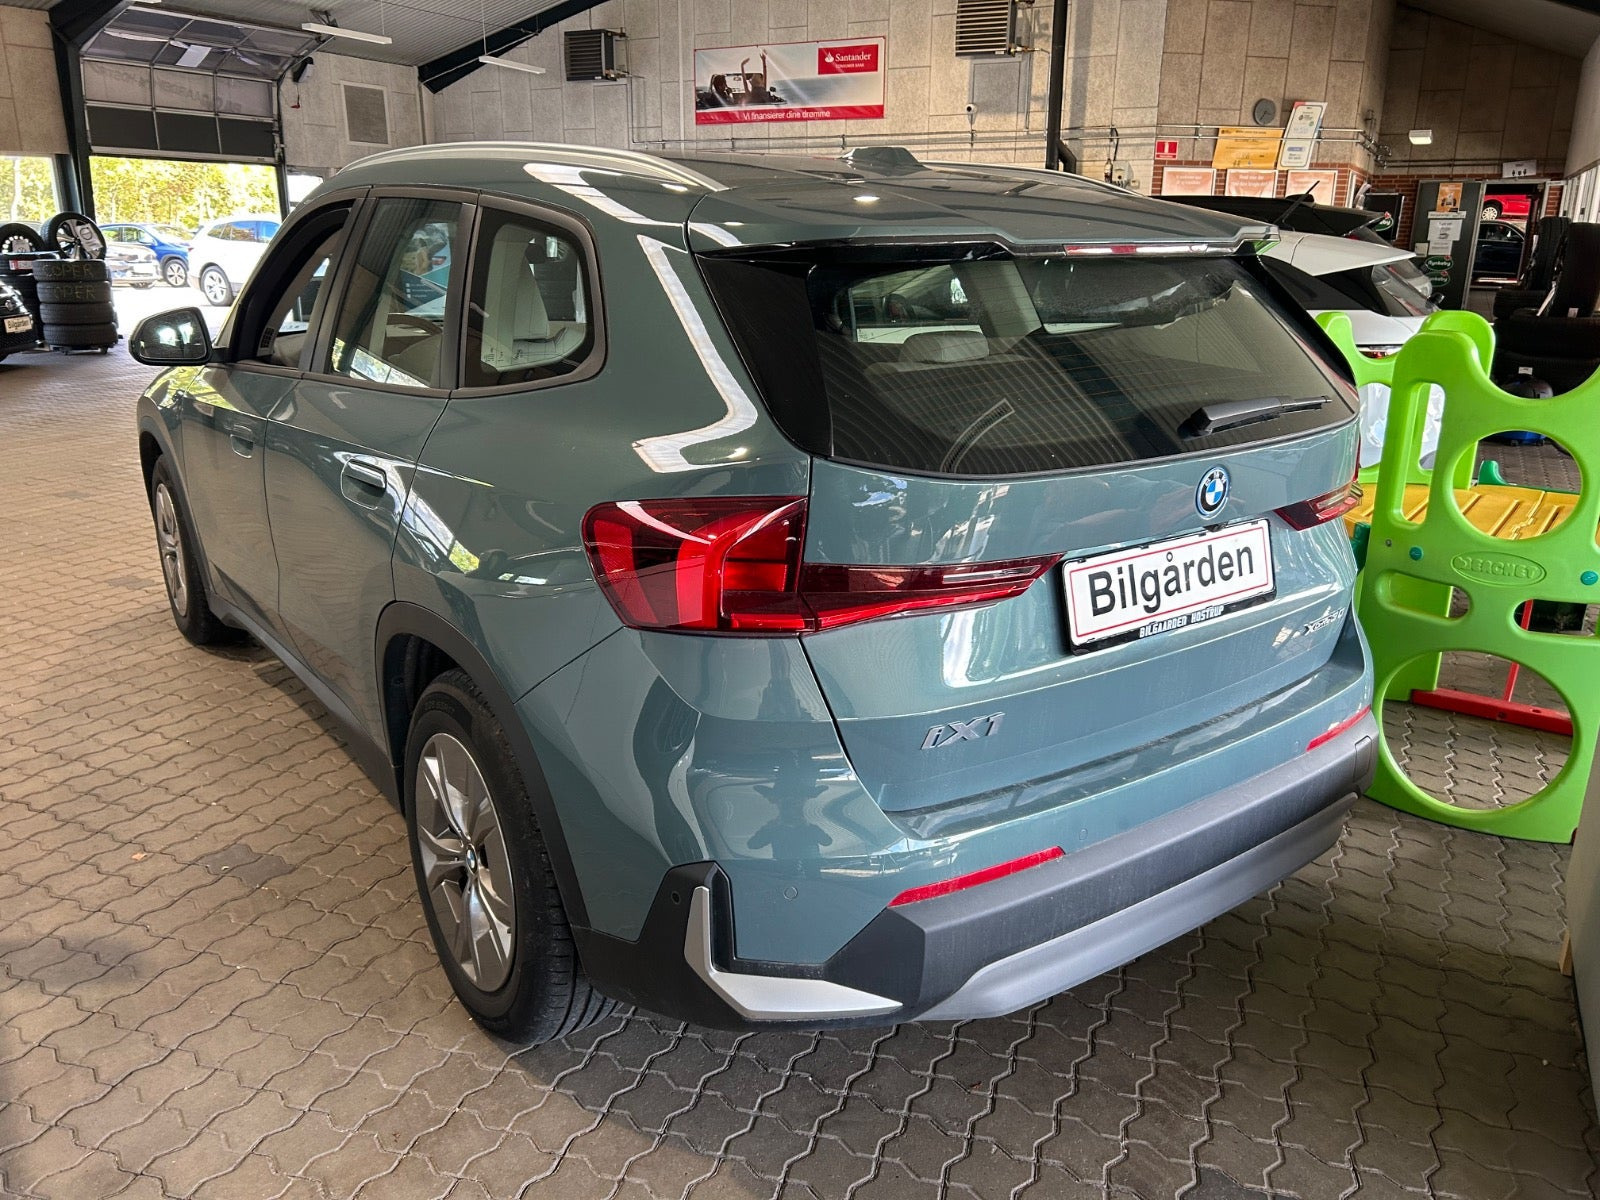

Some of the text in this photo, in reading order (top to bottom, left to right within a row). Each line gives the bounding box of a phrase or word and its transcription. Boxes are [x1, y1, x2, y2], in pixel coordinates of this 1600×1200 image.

[835, 51, 871, 62] Santander
[743, 112, 750, 120] Vi
[751, 111, 785, 120] finansierer
[786, 110, 801, 118] dine
[1088, 545, 1254, 617] Bilgården
[1139, 605, 1225, 638] BILGAARDEN HOSTRUP
[920, 712, 1006, 750] iX1
